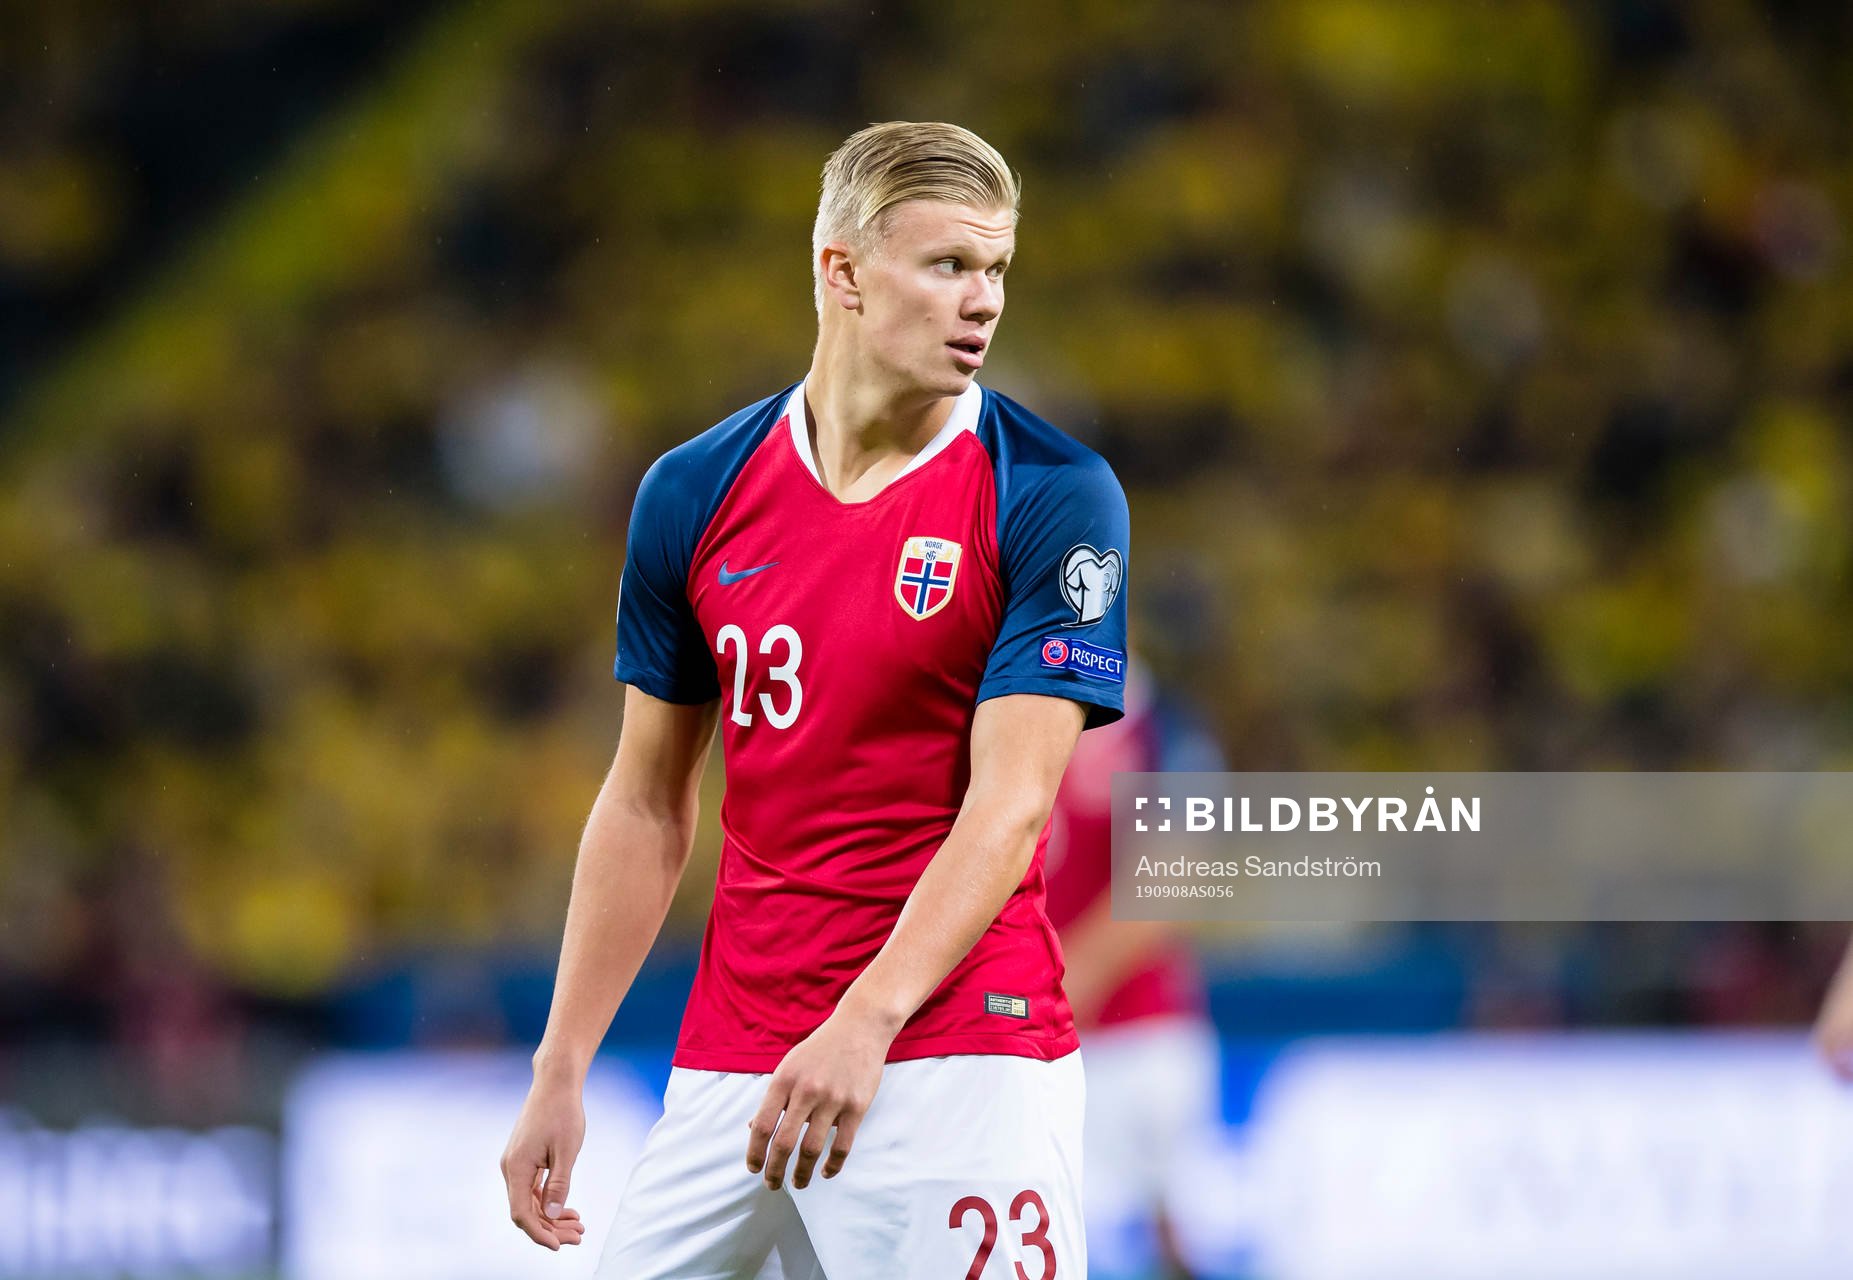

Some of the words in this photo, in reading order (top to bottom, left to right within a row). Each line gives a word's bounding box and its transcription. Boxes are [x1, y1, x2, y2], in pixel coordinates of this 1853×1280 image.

[925, 540, 943, 550] NORGE
[716, 624, 803, 730] 23
[1072, 648, 1122, 674] RESPECT
[949, 1189, 1056, 1280] 23
